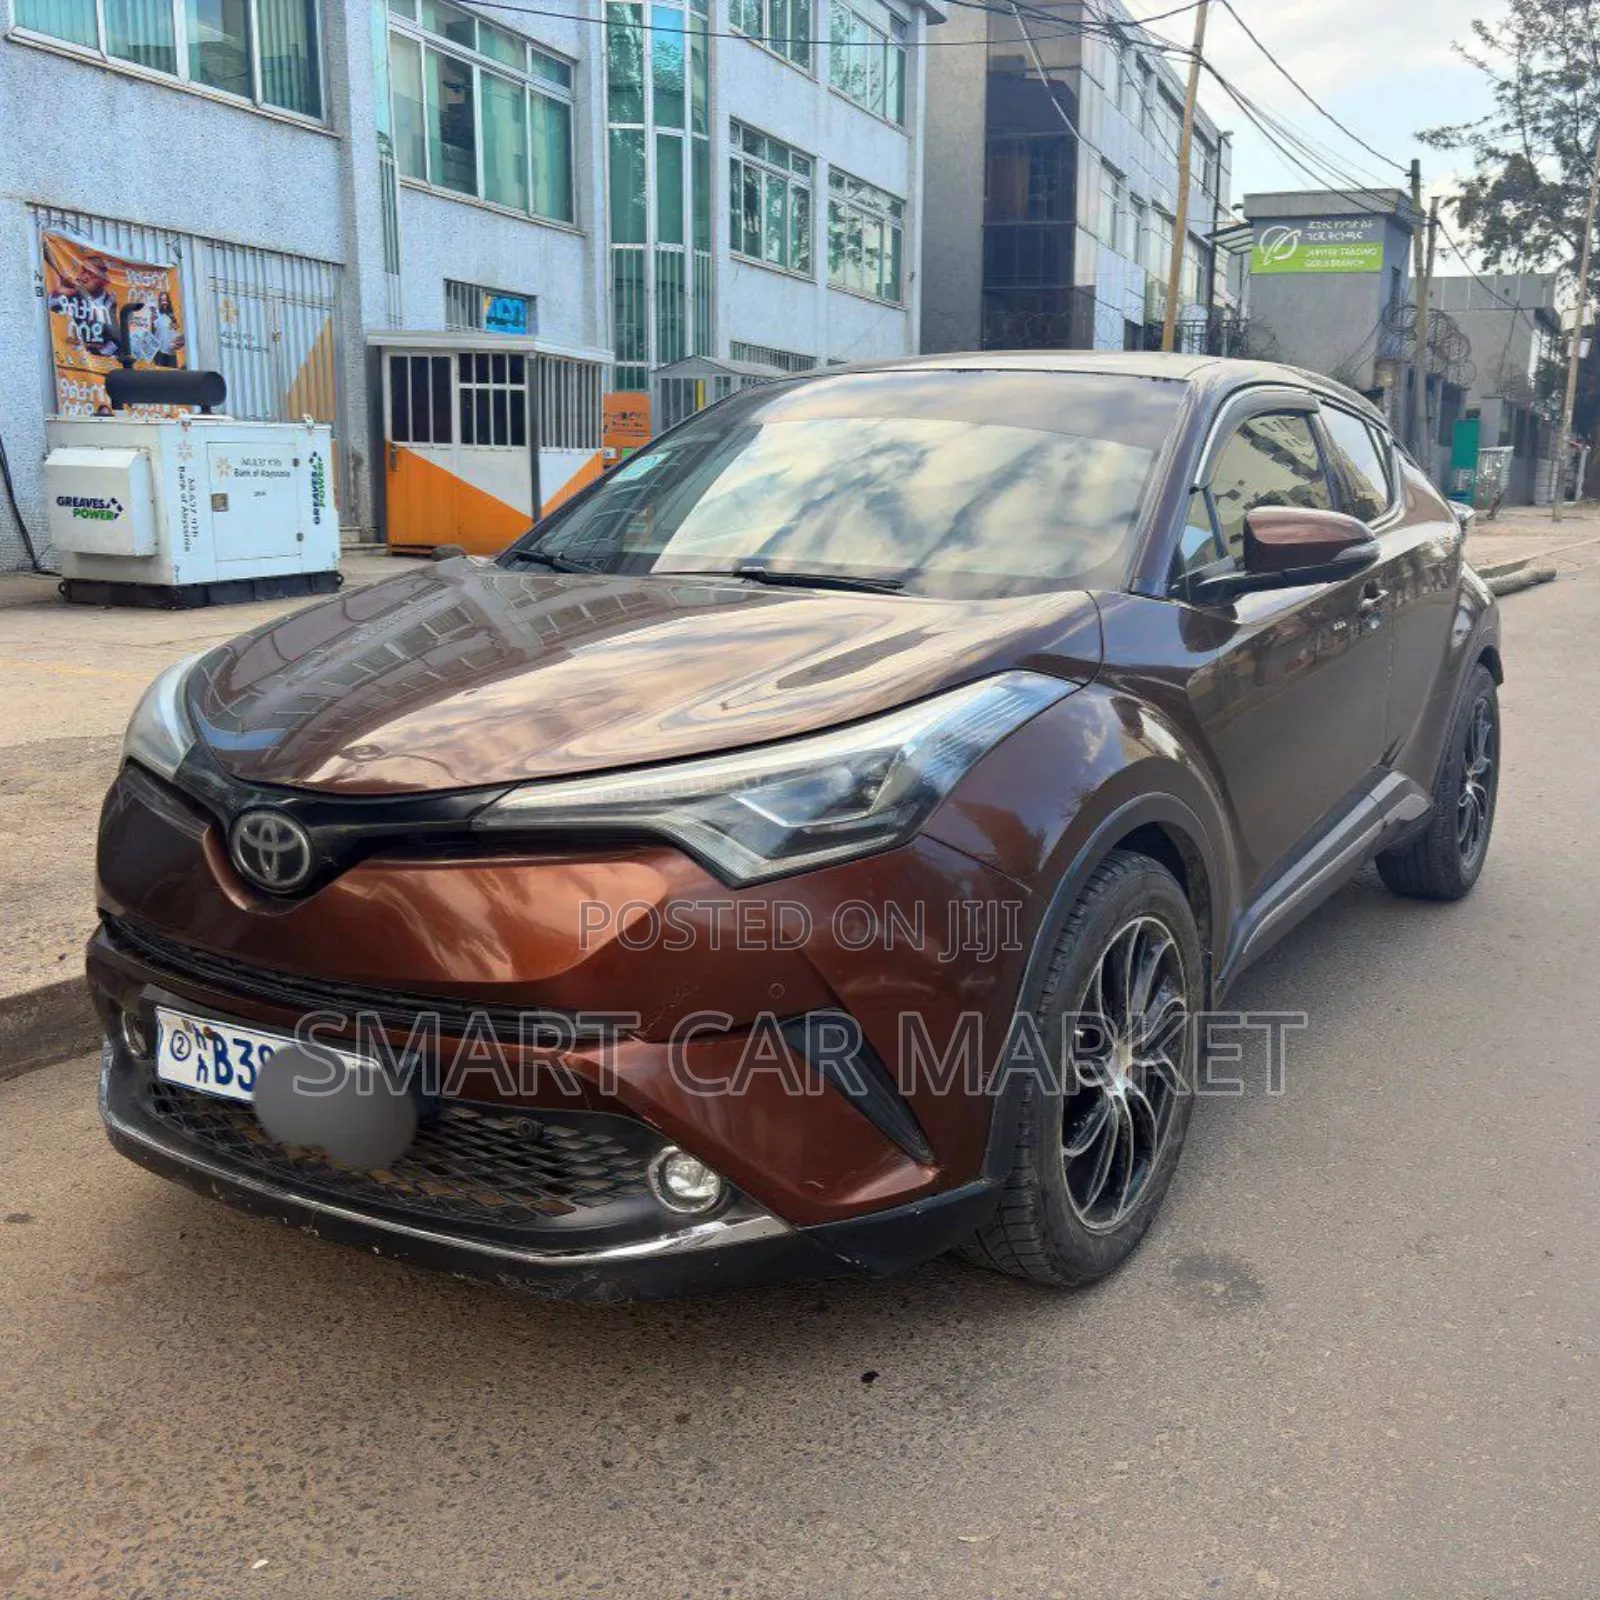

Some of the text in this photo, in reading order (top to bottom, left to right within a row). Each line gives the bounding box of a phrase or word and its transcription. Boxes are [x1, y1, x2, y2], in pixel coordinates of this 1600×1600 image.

[310, 471, 321, 525] GREAVES
[316, 461, 326, 507] POWER
[56, 496, 105, 509] GREAVES
[72, 507, 115, 520] POWER
